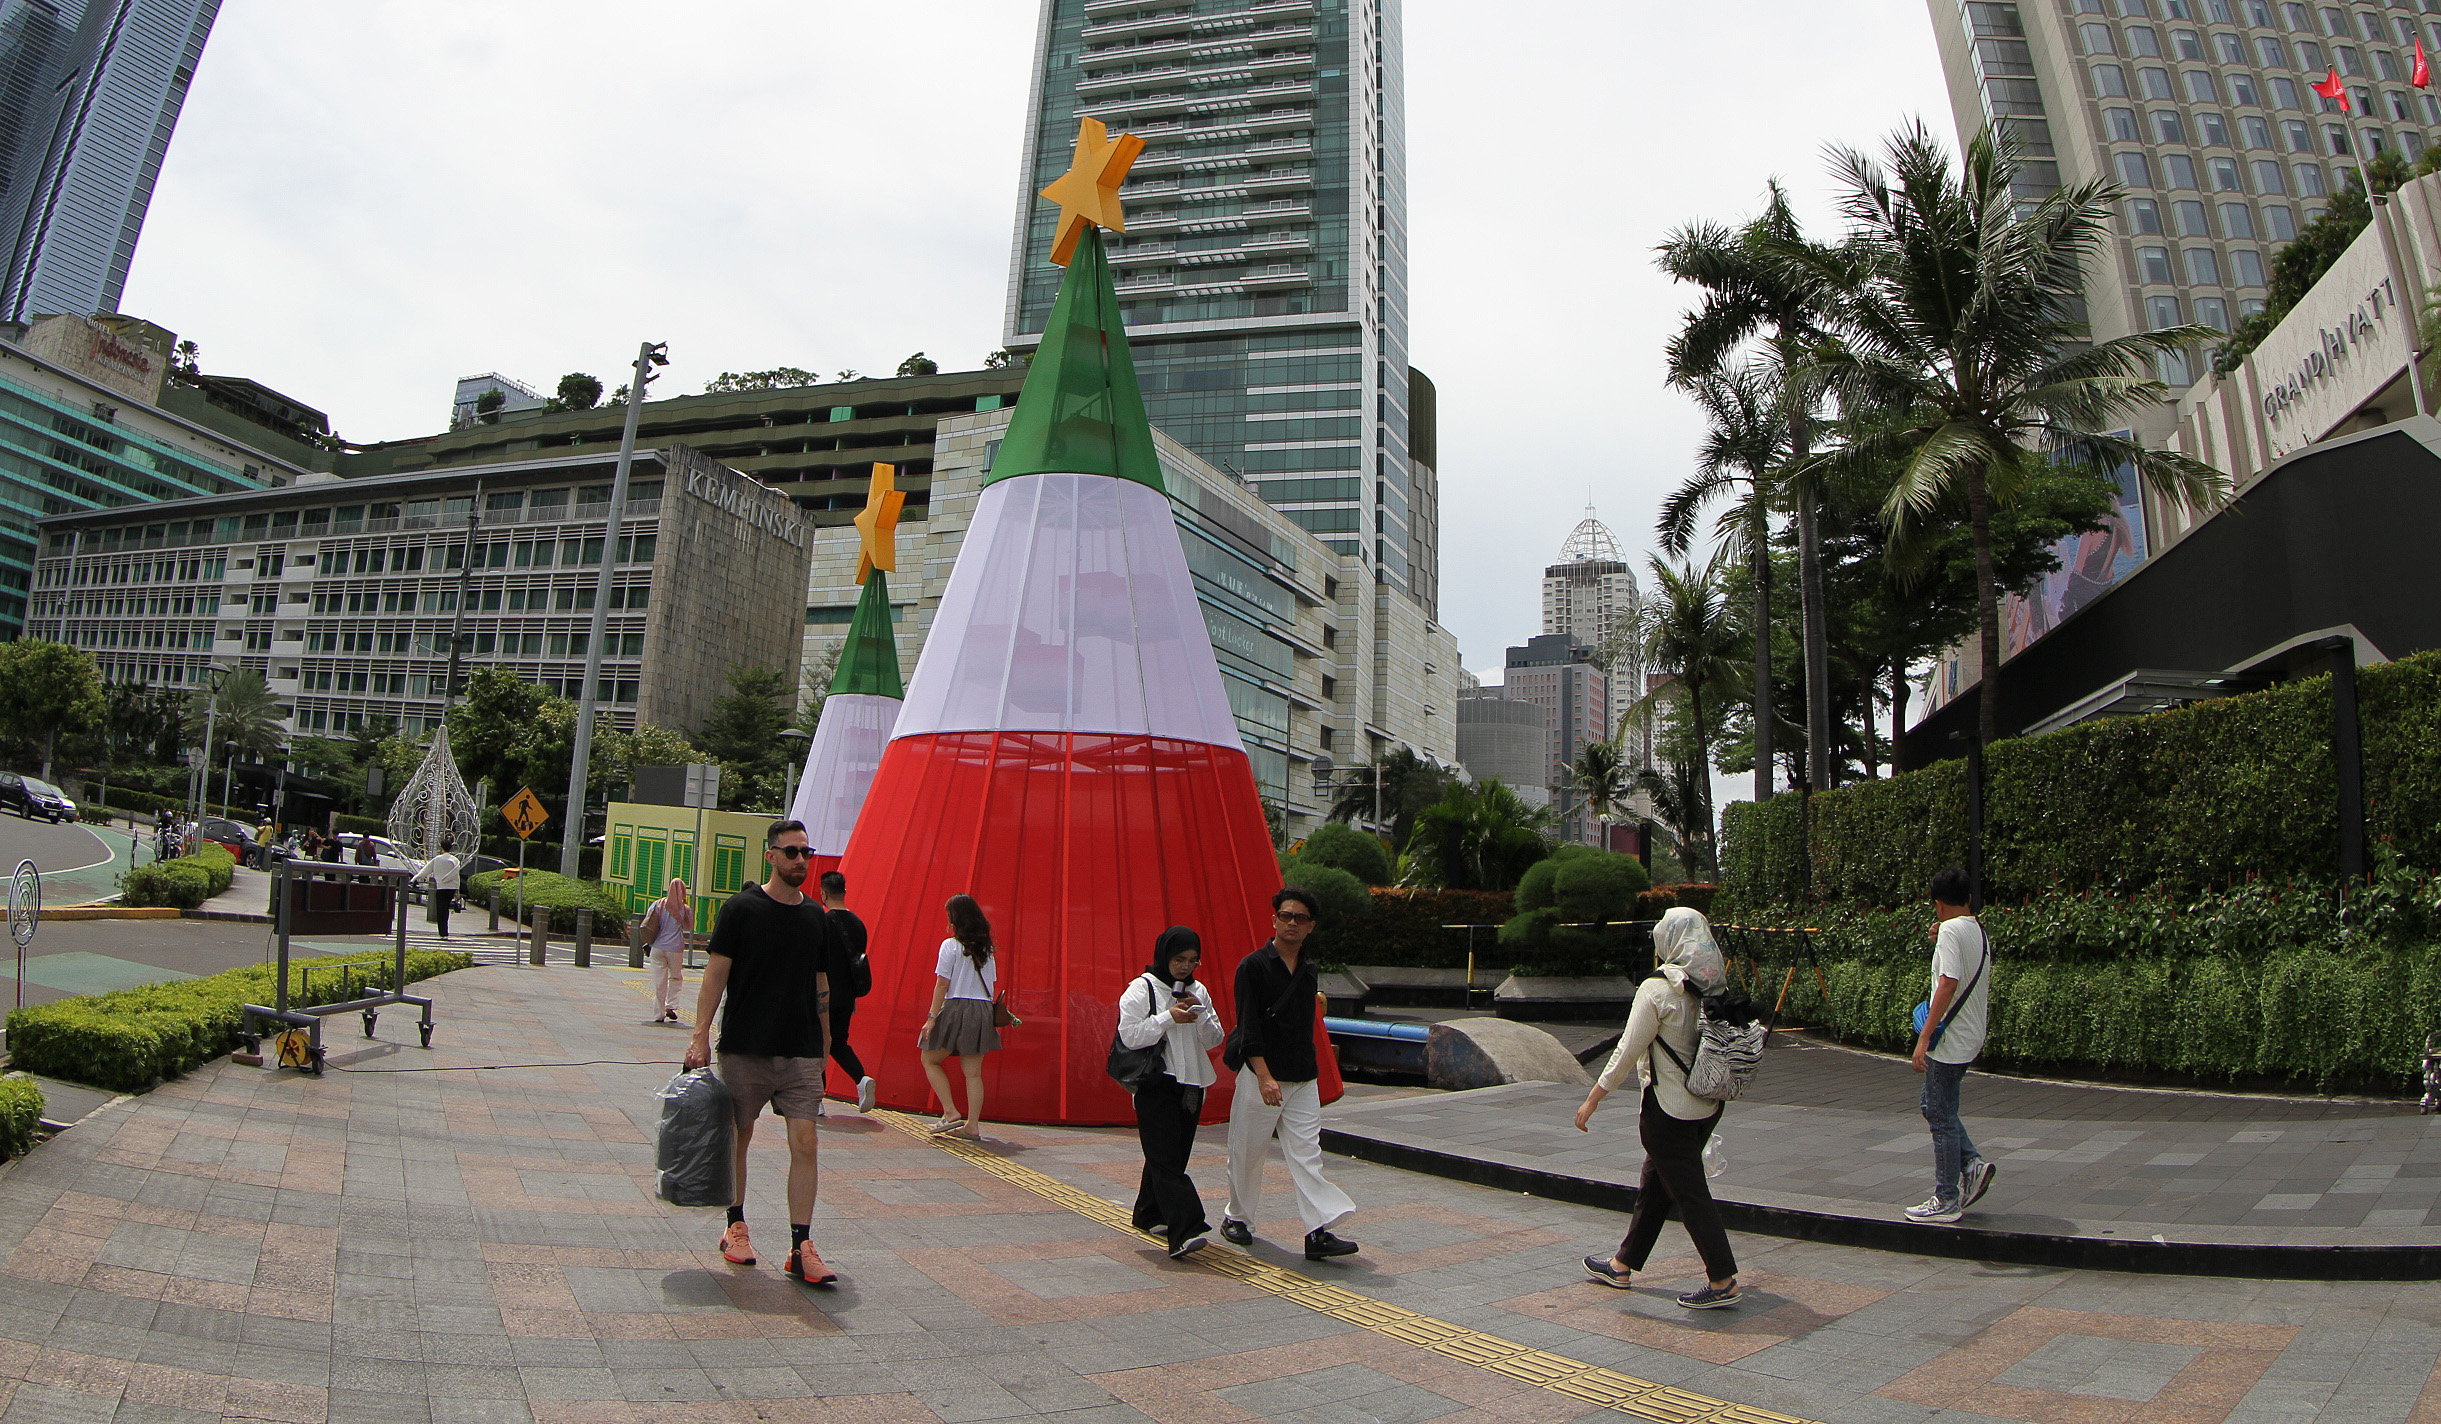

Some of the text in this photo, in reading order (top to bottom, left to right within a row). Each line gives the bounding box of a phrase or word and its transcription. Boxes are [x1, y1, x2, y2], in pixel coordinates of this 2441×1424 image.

[87, 319, 111, 335] HOTEL
[2264, 350, 2323, 419] GRAND
[686, 468, 807, 547] KEMPINSKI
